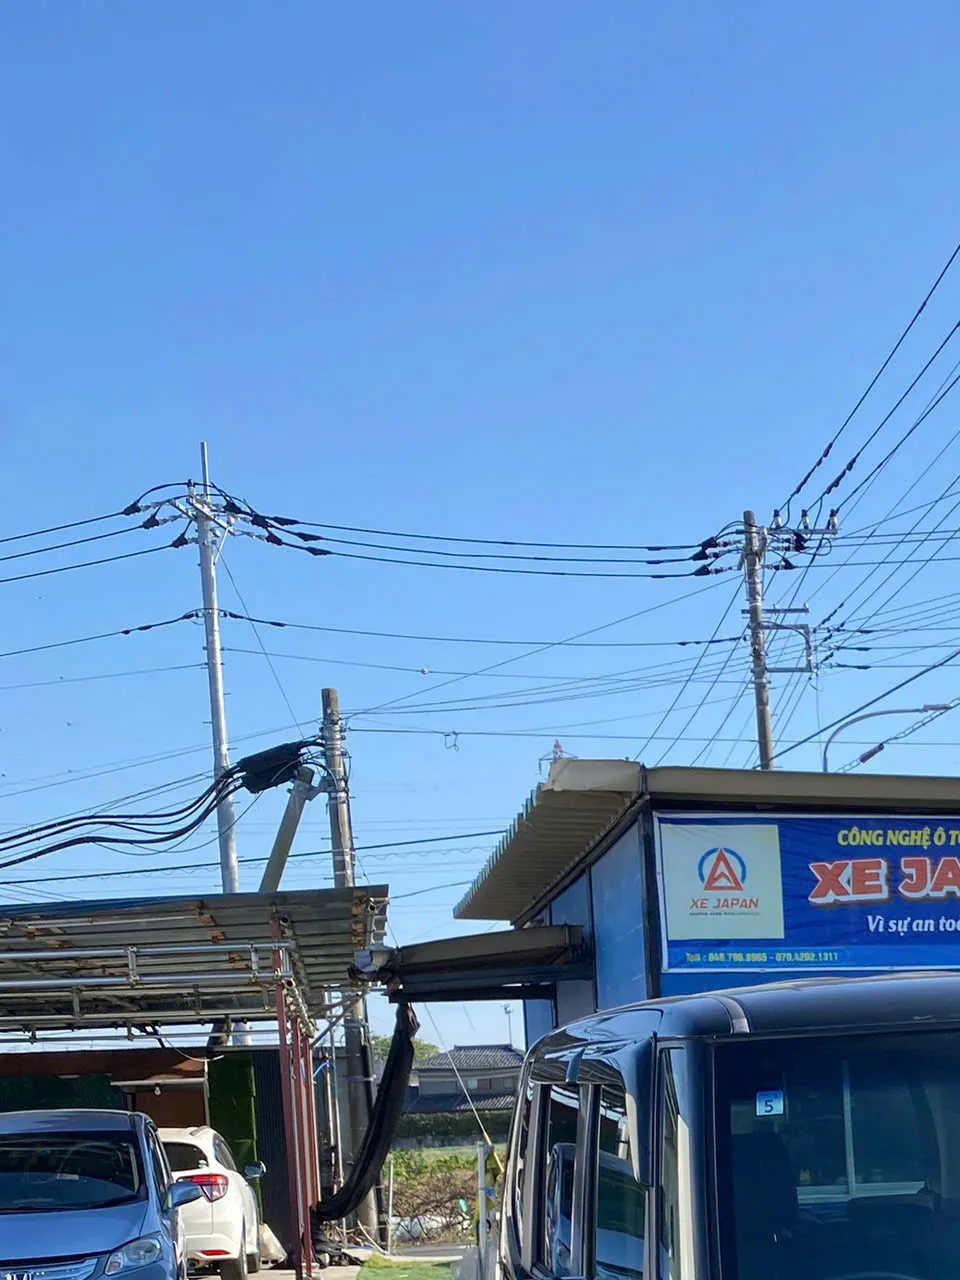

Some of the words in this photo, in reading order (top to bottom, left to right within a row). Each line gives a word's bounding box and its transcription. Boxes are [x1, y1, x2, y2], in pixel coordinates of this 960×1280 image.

[837, 826, 884, 846] CÔNG
[886, 826, 930, 850] NGHỆ
[933, 826, 946, 846] Ô
[808, 858, 888, 902] XE
[690, 898, 709, 909] XE
[713, 898, 760, 909] JAPAN
[867, 915, 885, 932] Vì
[888, 917, 911, 936] sự
[912, 918, 935, 932] an
[764, 1099, 774, 1113] 5
